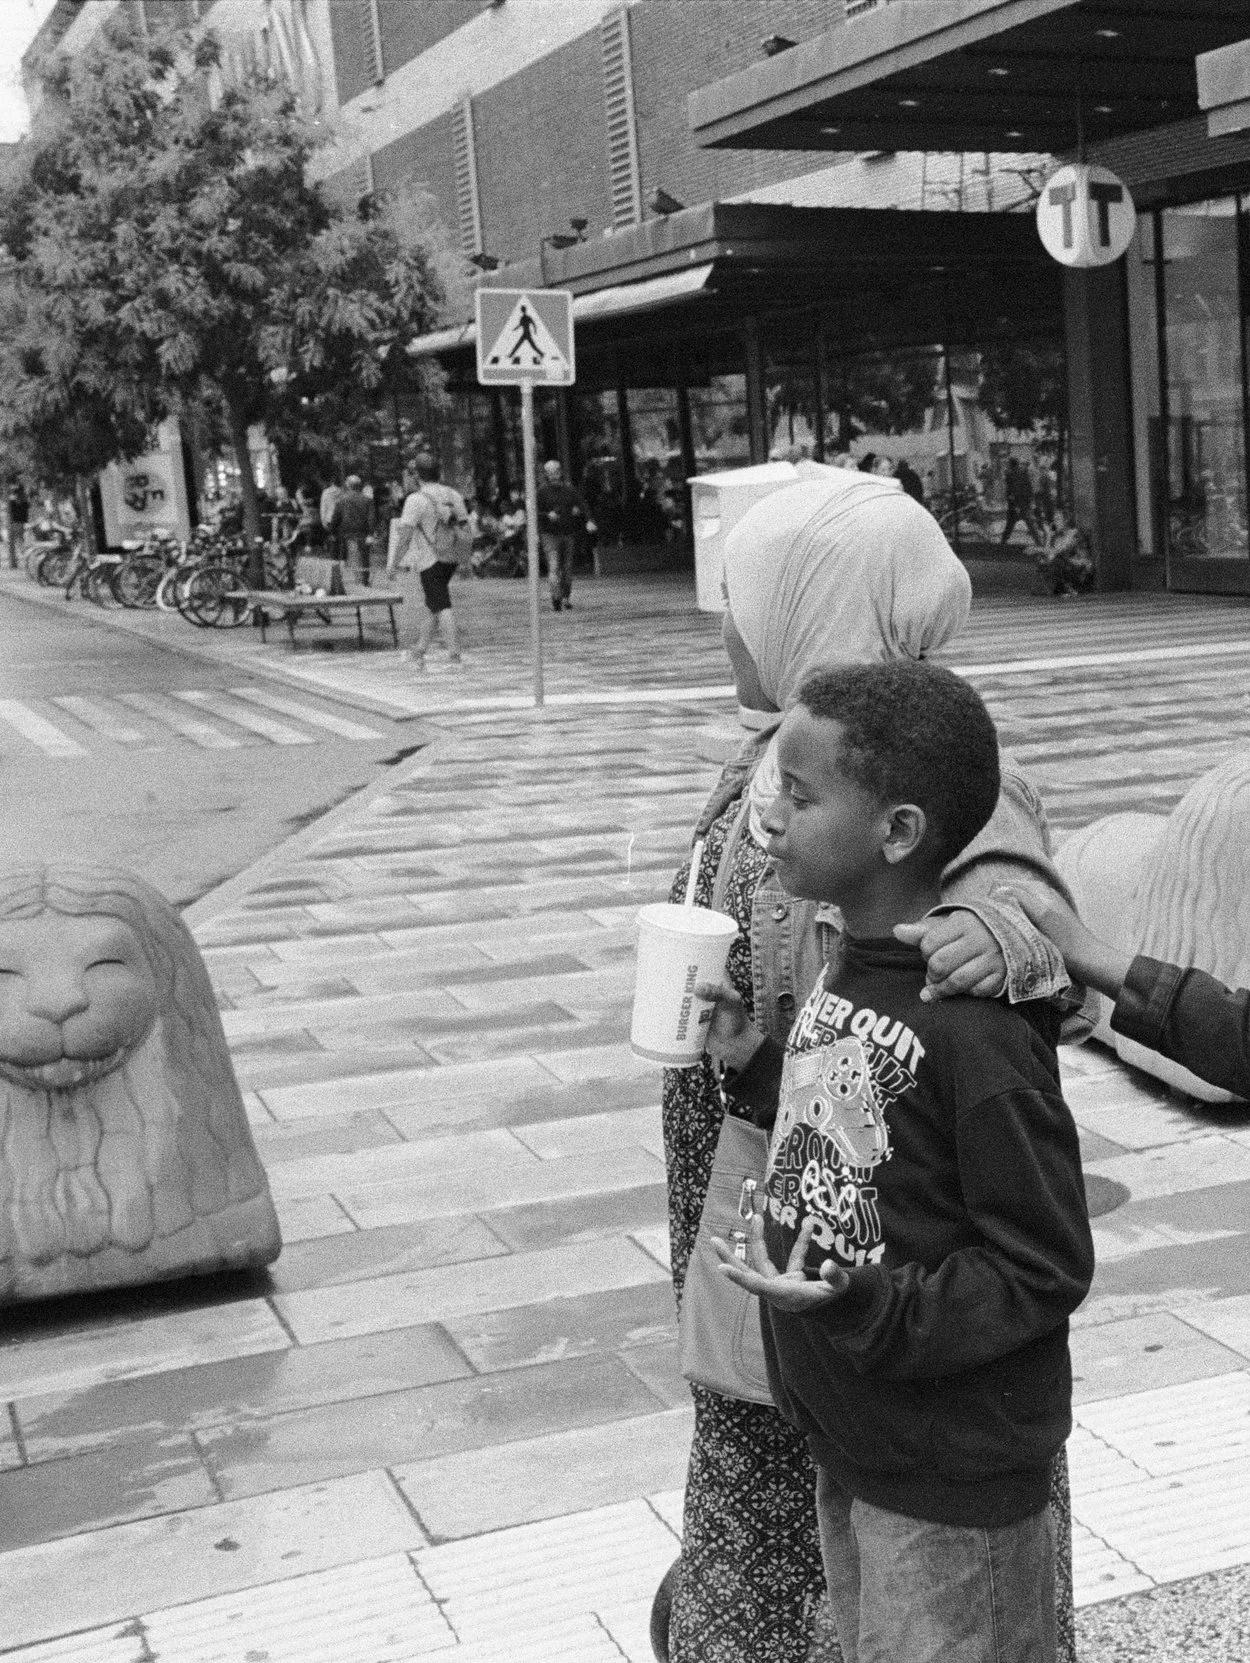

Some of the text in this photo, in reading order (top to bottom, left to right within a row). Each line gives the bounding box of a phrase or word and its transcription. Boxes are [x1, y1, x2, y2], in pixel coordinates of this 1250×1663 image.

[1087, 181, 1123, 248] T
[675, 964, 699, 1041] BURGER KING
[850, 1007, 926, 1076] QUIT
